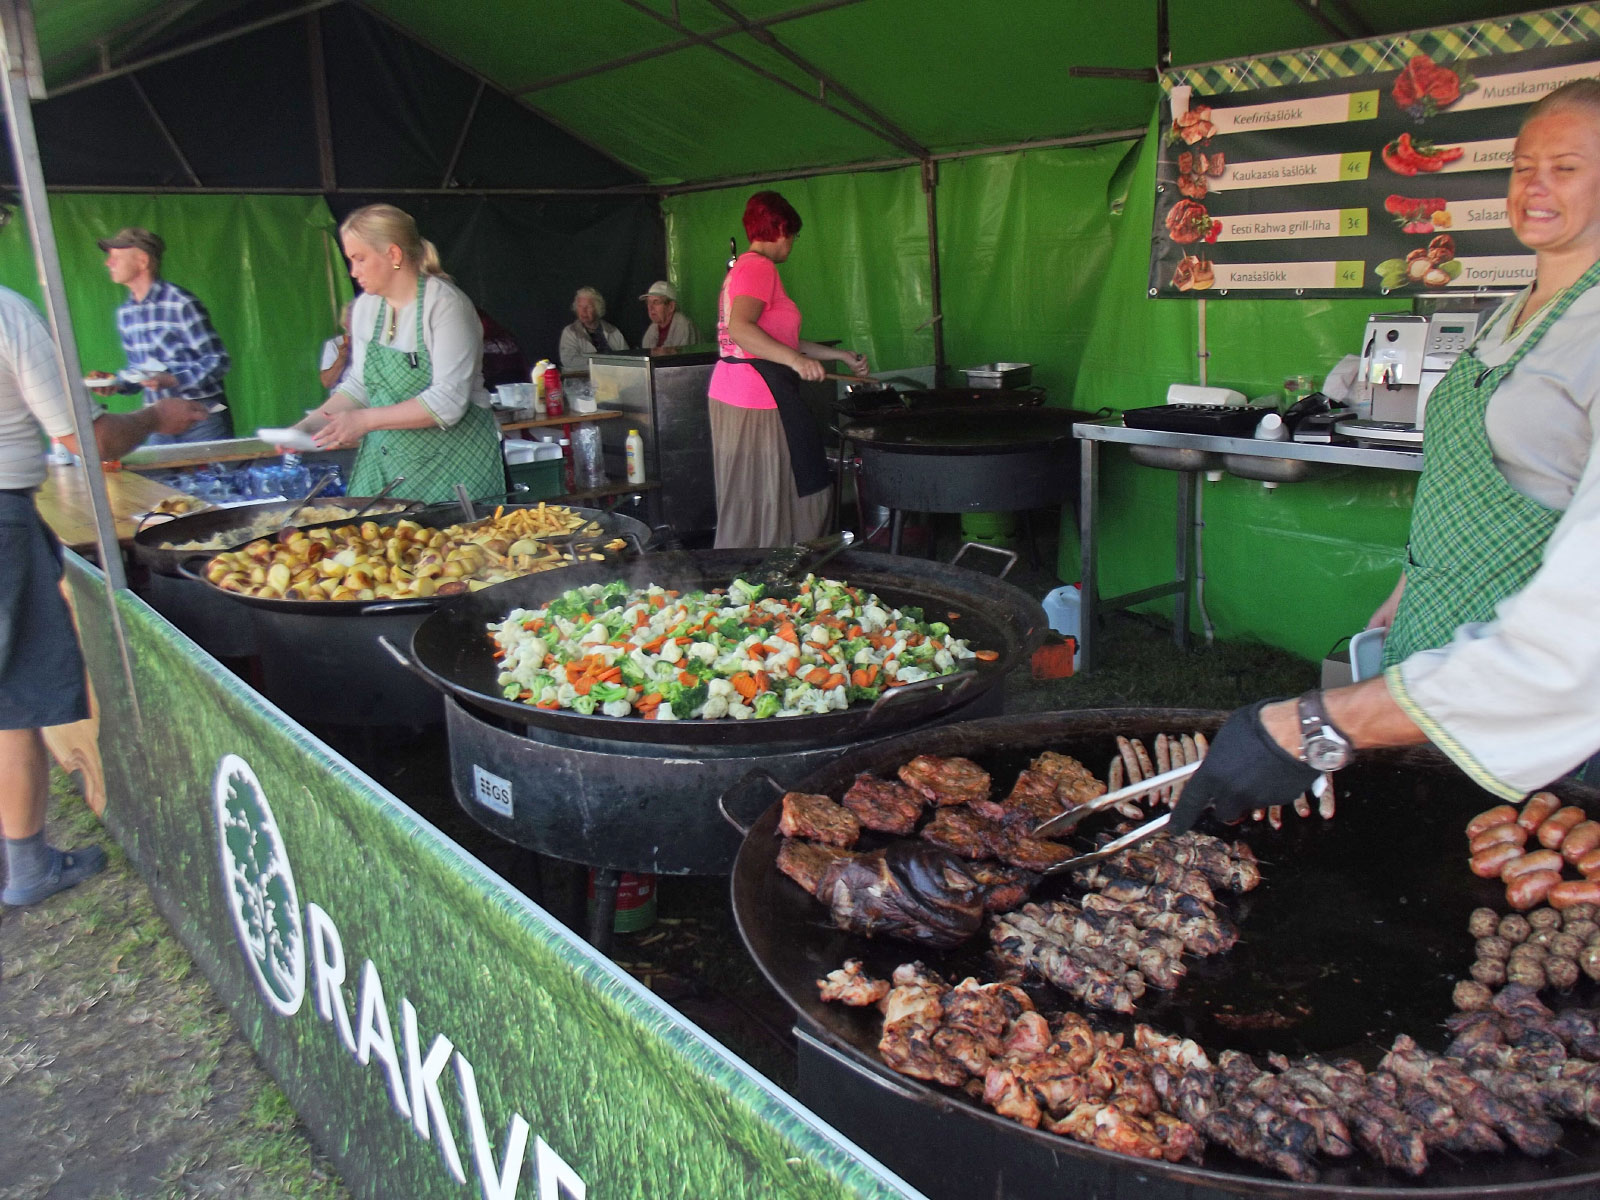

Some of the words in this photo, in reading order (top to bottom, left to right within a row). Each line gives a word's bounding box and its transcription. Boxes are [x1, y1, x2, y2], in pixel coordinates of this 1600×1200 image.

[1356, 101, 1370, 114] 3€
[1473, 151, 1515, 163] Lasteg
[1347, 161, 1361, 173] 4€
[1232, 168, 1280, 181] Kaukaasia
[1231, 223, 1252, 235] Eesti
[1254, 221, 1287, 234] Rahwa
[1289, 219, 1332, 235] grill-liha
[1347, 217, 1361, 229] 3€
[1342, 271, 1356, 281] 4€
